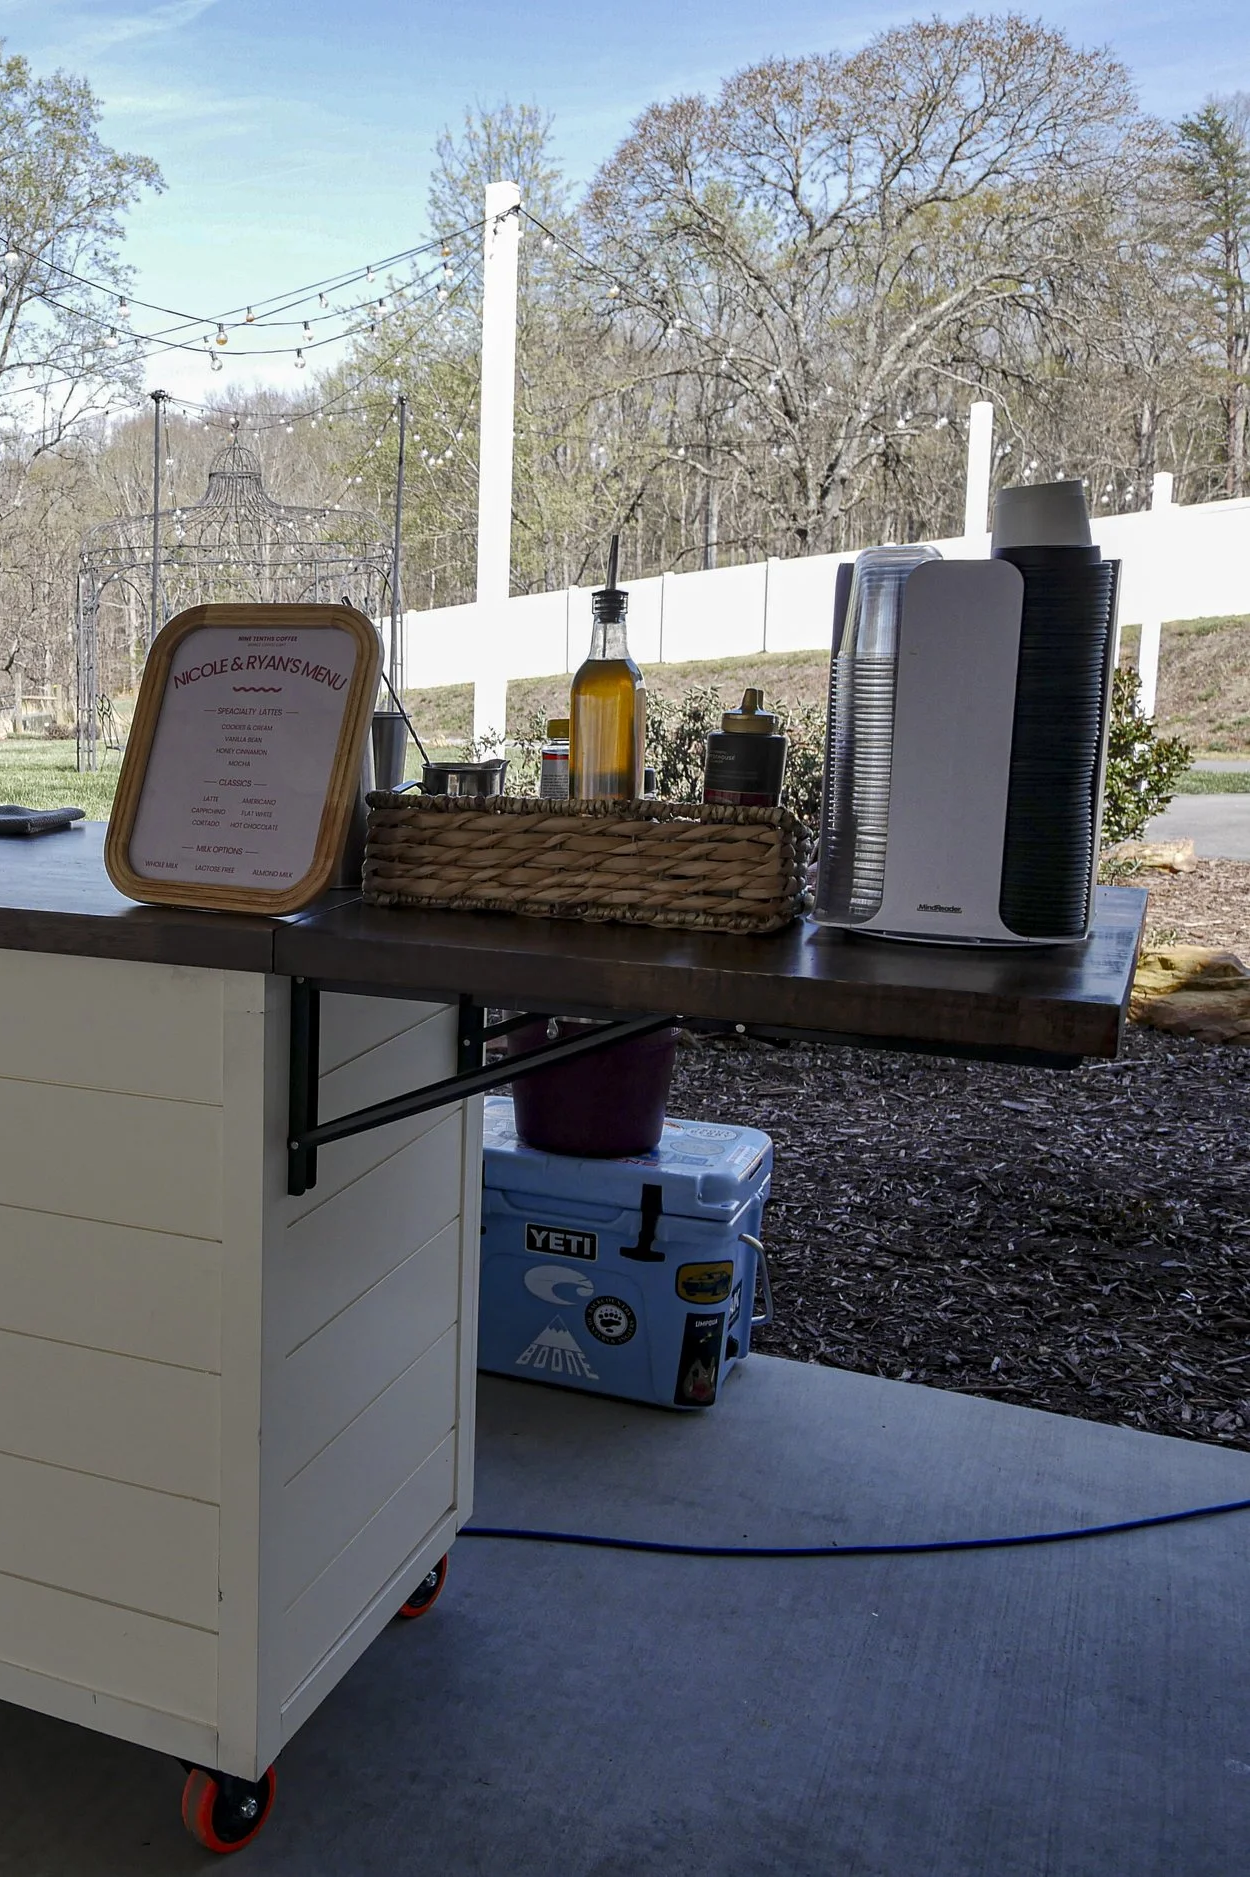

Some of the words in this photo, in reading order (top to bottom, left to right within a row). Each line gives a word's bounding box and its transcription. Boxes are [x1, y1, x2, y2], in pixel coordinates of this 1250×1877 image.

[173, 657, 229, 689] NICOLE
[230, 656, 244, 671] &
[246, 654, 302, 673] RYAN'S
[301, 661, 348, 691] MENU
[217, 706, 257, 716] SPEACIALTY
[259, 708, 283, 716] LATTES
[221, 723, 246, 731] COOKIES
[235, 748, 268, 756] CINNAMON
[218, 778, 252, 788] CLASSICS
[203, 795, 219, 803] LATTE
[241, 797, 277, 806] AMERICANO
[240, 810, 254, 818] FLAT
[191, 819, 220, 828] CORTADO
[230, 821, 243, 829] HOT
[243, 822, 279, 832] CHOCOLATE
[196, 845, 212, 854] MILK
[212, 846, 244, 856] OPTIONS
[145, 860, 165, 869] WHOLE
[165, 861, 179, 870] MILK
[195, 864, 221, 873] LACTOSE
[221, 865, 236, 874] FREE
[252, 869, 278, 878] ALMOND
[278, 870, 294, 879] MILK
[529, 1228, 591, 1256] YETI
[514, 1345, 600, 1380] BOONE
